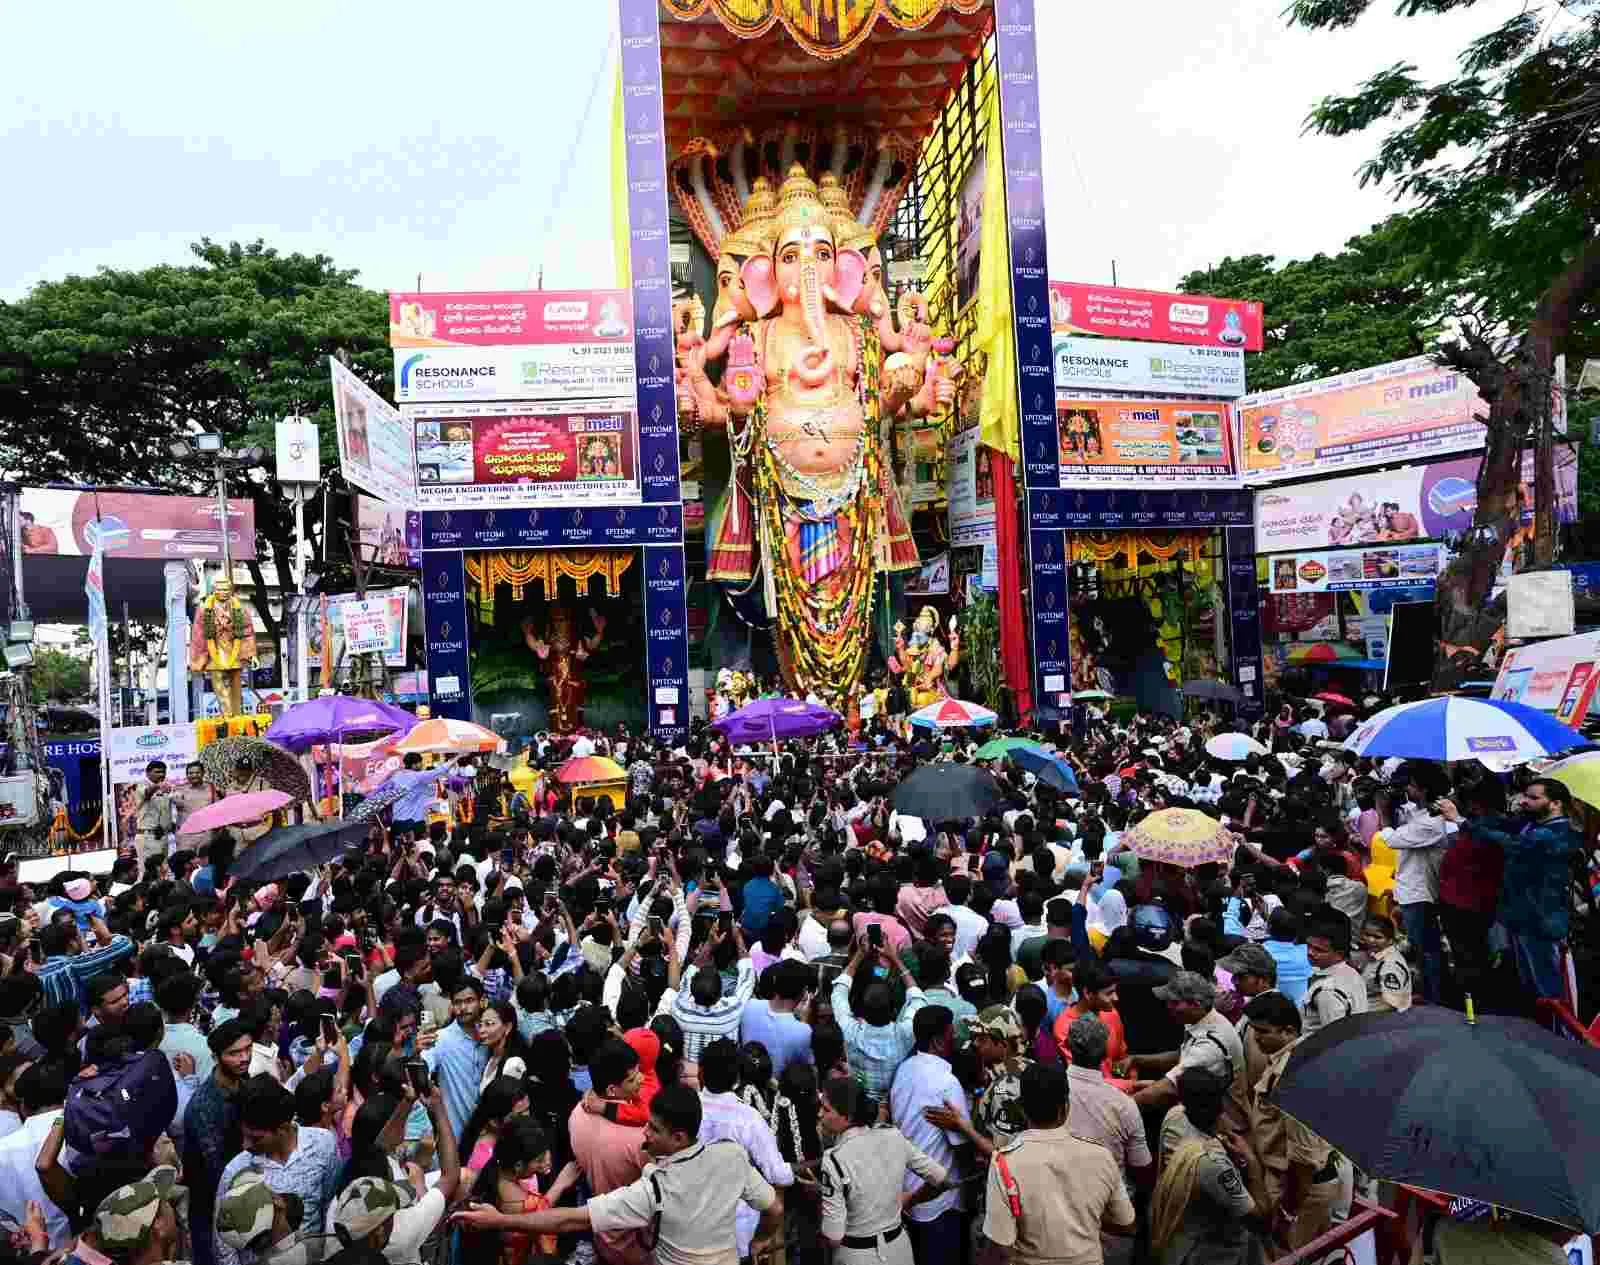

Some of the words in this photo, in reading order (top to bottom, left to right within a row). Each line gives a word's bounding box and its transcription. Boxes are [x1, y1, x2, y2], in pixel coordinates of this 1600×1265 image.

[1061, 355, 1129, 369] RESONANCE
[415, 366, 497, 378] RESONANCE
[1061, 367, 1112, 379] SCHOOLS
[415, 378, 475, 390] SCHOOLS
[1408, 375, 1457, 398] meil
[1134, 409, 1160, 421] meil
[586, 415, 624, 431] meil
[641, 425, 673, 434] EPITOME
[420, 487, 453, 496] MEGHA
[475, 530, 505, 538] EPITOME
[518, 529, 549, 537] EPITOME
[562, 528, 593, 536] EPITOME
[605, 527, 636, 536] EPITOME
[648, 526, 678, 534] EPITOME
[431, 531, 462, 539] EPITOME
[648, 579, 681, 588] EPITOME
[427, 591, 460, 600] EPITOME
[650, 628, 682, 637] EPITOME
[430, 641, 463, 650] EPITOME
